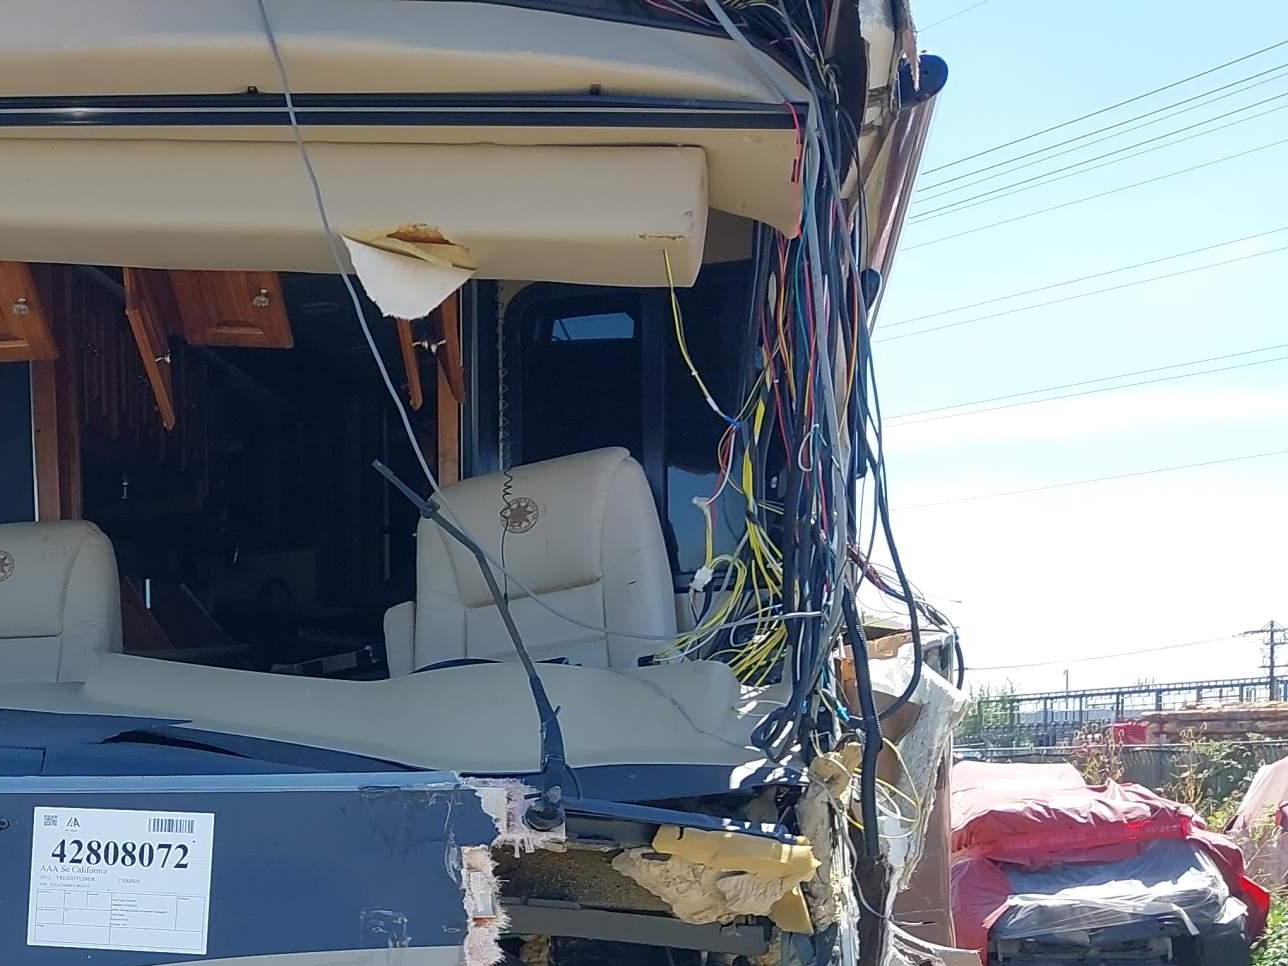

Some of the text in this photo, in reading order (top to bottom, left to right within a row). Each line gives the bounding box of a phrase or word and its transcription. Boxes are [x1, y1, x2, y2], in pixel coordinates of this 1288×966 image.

[51, 839, 189, 869] 42808072
[40, 865, 59, 873] AAA
[71, 866, 108, 875] California
